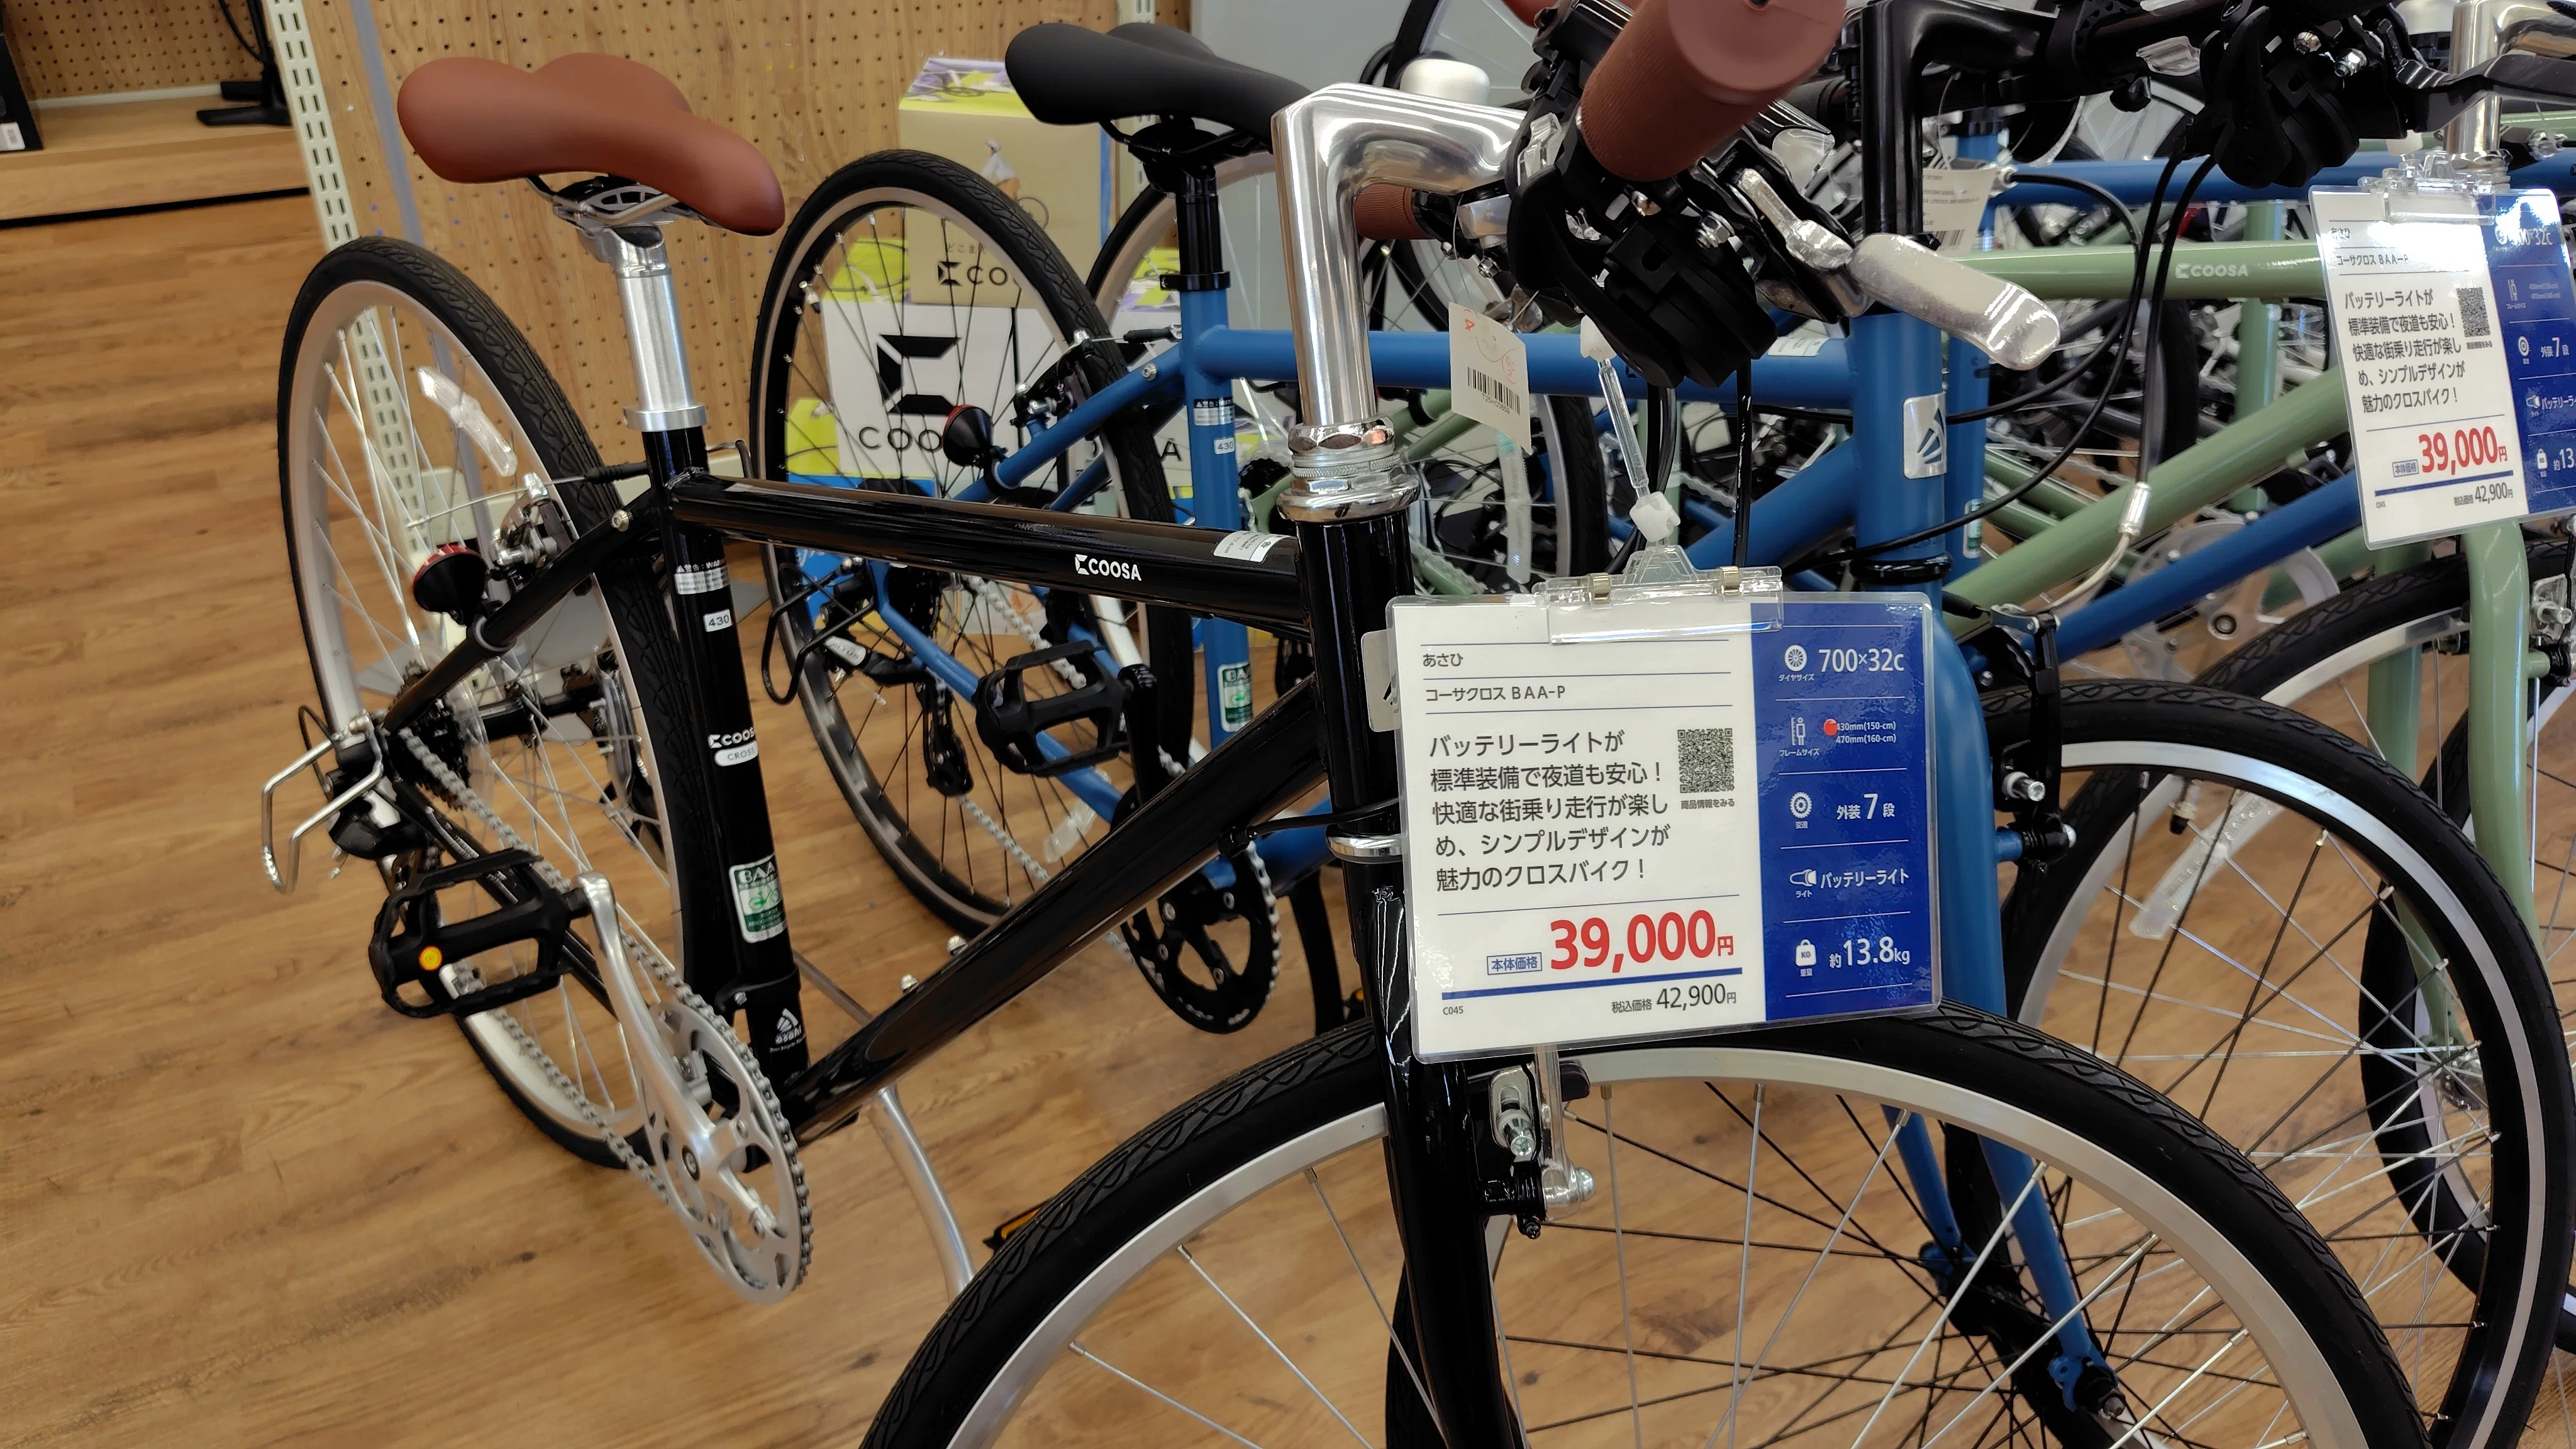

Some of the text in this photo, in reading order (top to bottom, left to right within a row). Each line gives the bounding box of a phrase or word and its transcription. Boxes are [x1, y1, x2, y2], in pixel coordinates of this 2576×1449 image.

[2190, 263, 2249, 277] COOSA
[2337, 254, 2377, 265] コーサクロス
[2345, 288, 2434, 309] バッテリーライトが
[2348, 313, 2455, 336] 標準装備で夜道も安心！
[2352, 337, 2462, 362] 快適な街乗り走行が楽し
[2358, 360, 2465, 387] め、シンプルデザインが
[2362, 387, 2458, 413] 魅力のクロスバイク！
[1218, 441, 1233, 451] 430
[2419, 426, 2507, 475] 39,000円
[2475, 482, 2513, 504] 42,900円
[1088, 558, 1142, 581] COOSA
[708, 614, 730, 626] 430
[1423, 653, 1463, 667] あさひ
[1818, 648, 1904, 672] 700×32c
[1779, 674, 1814, 682] タイヤサイズ
[1426, 686, 1565, 702] コーサクロス BAA-P
[1430, 730, 1625, 757] バッテリーライトが
[1836, 735, 1896, 744] 470mm(160-cm)
[727, 747, 755, 761] CROSS
[1779, 748, 1819, 757] フレームサイズ
[1431, 762, 1662, 792] 標準装備で夜道も安心！
[1433, 794, 1668, 825] 快適な街乗り走行が楽し
[1681, 799, 1735, 810] 商品情報をみる
[1836, 794, 1895, 820] 外装7段
[1435, 824, 1670, 857] め、シンプルデザインが
[740, 861, 776, 884] BAA
[1436, 859, 1645, 892] 魅力のクロスバイク！
[1821, 868, 1909, 889] バッテリーライト
[1796, 890, 1812, 898] ライト
[1550, 909, 1734, 974] 39,000円
[1829, 936, 1910, 969] 約13.8kg
[1491, 956, 1538, 972] 本体価格
[1611, 983, 1736, 1014] 税込価格 42,900円
[1443, 1006, 1463, 1016] C045
